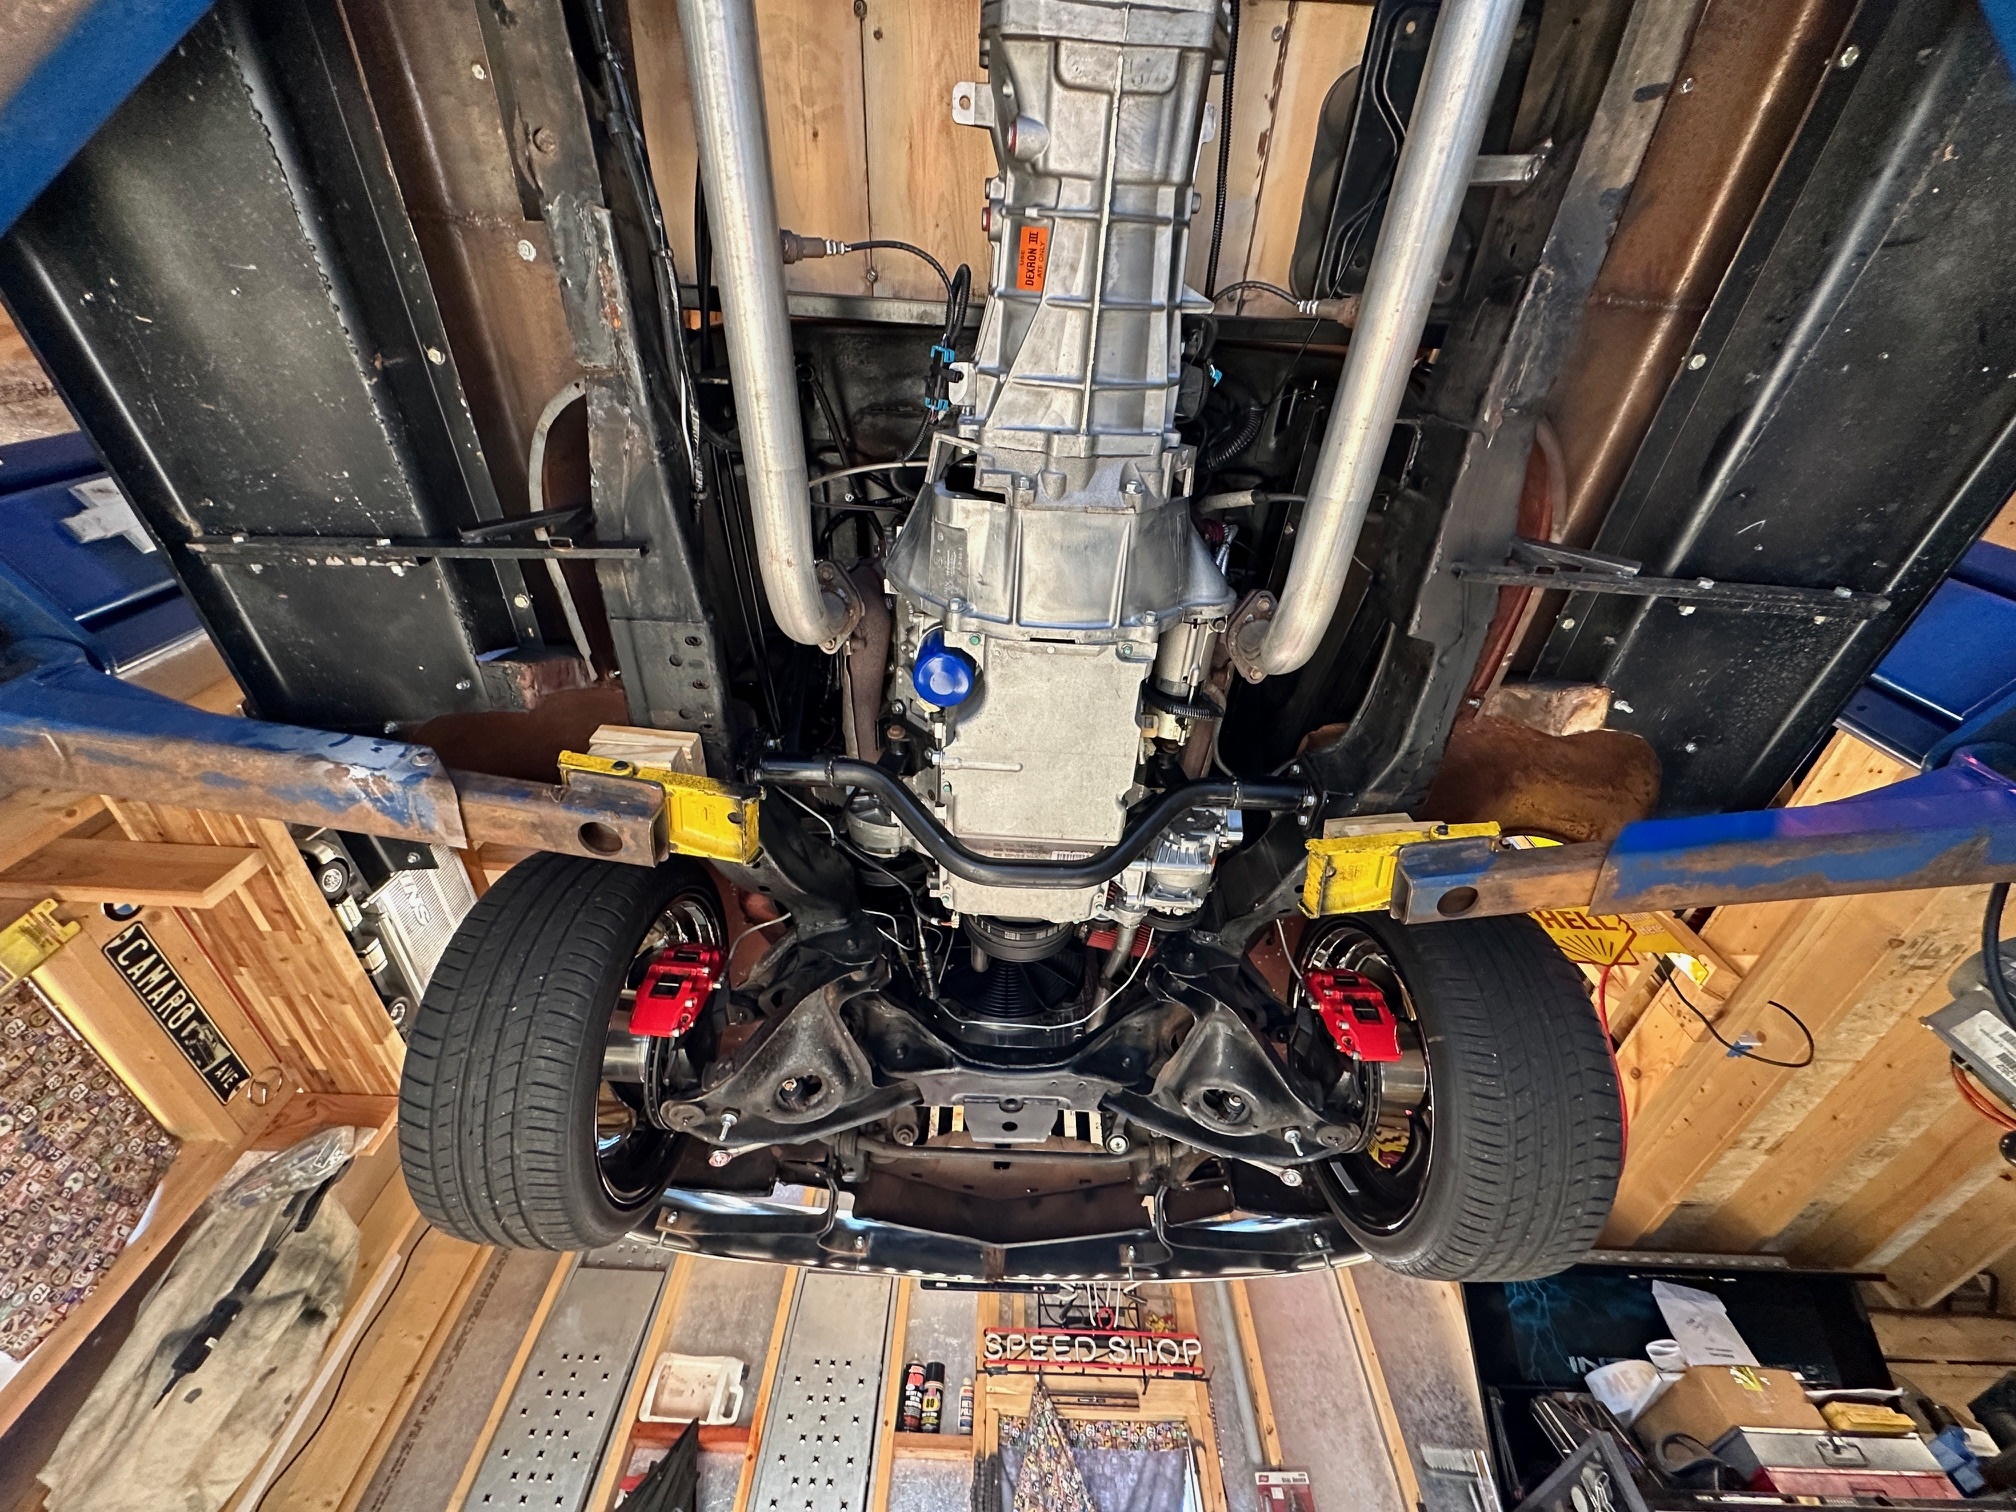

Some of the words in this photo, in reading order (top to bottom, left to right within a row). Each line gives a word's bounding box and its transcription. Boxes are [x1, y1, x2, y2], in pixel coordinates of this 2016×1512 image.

[1029, 231, 1039, 245] III
[1038, 241, 1046, 262] ONLY
[1025, 248, 1037, 286] DEXRON
[1534, 911, 1618, 931] HELL
[117, 938, 196, 1030] CAMARO
[214, 1063, 240, 1090] AVE
[984, 1332, 1097, 1363] SPEED
[1107, 1335, 1203, 1366] SHOP
